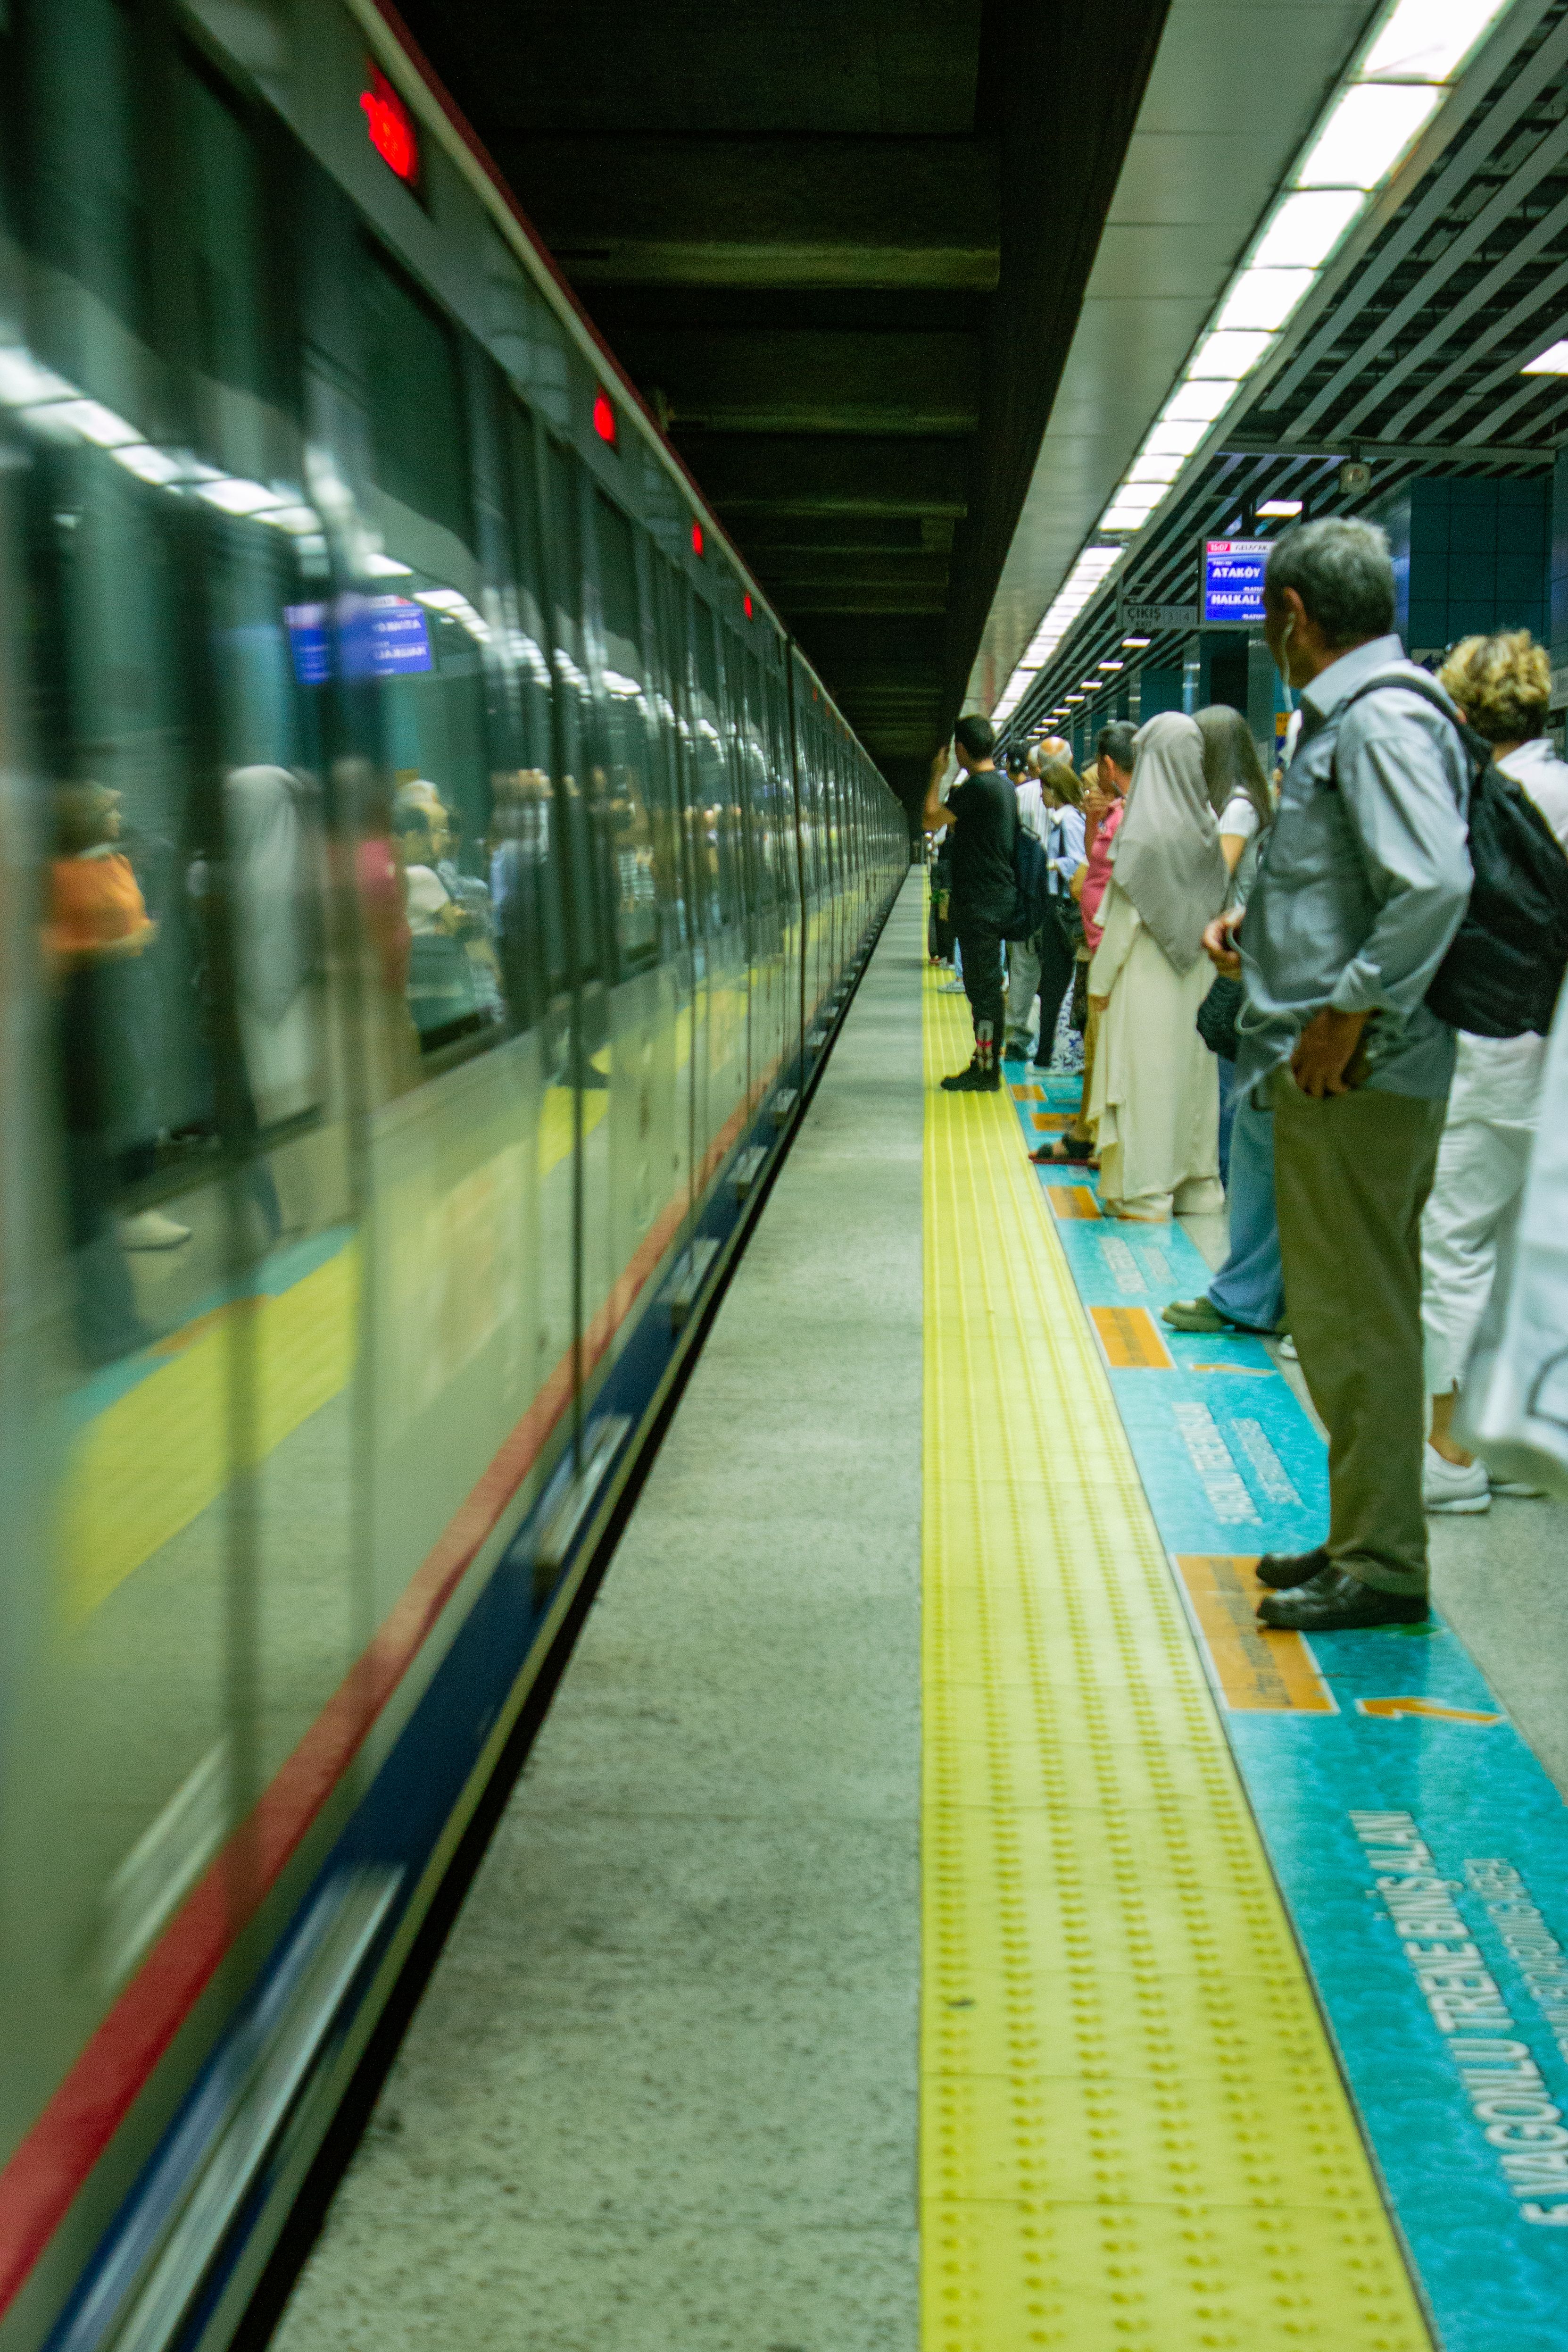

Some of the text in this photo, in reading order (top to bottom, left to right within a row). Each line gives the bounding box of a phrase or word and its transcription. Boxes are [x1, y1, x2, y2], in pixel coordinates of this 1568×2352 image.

[1212, 566, 1261, 578] ATAKÖY
[1128, 607, 1161, 621] ÇIKIŞ
[1211, 594, 1260, 605] HALKALI
[1348, 1810, 1436, 1877] ALANI
[1463, 1857, 1532, 1900] AREA
[1405, 1940, 1515, 2033] TRENE
[1448, 2037, 1568, 2197] VAGONLU
